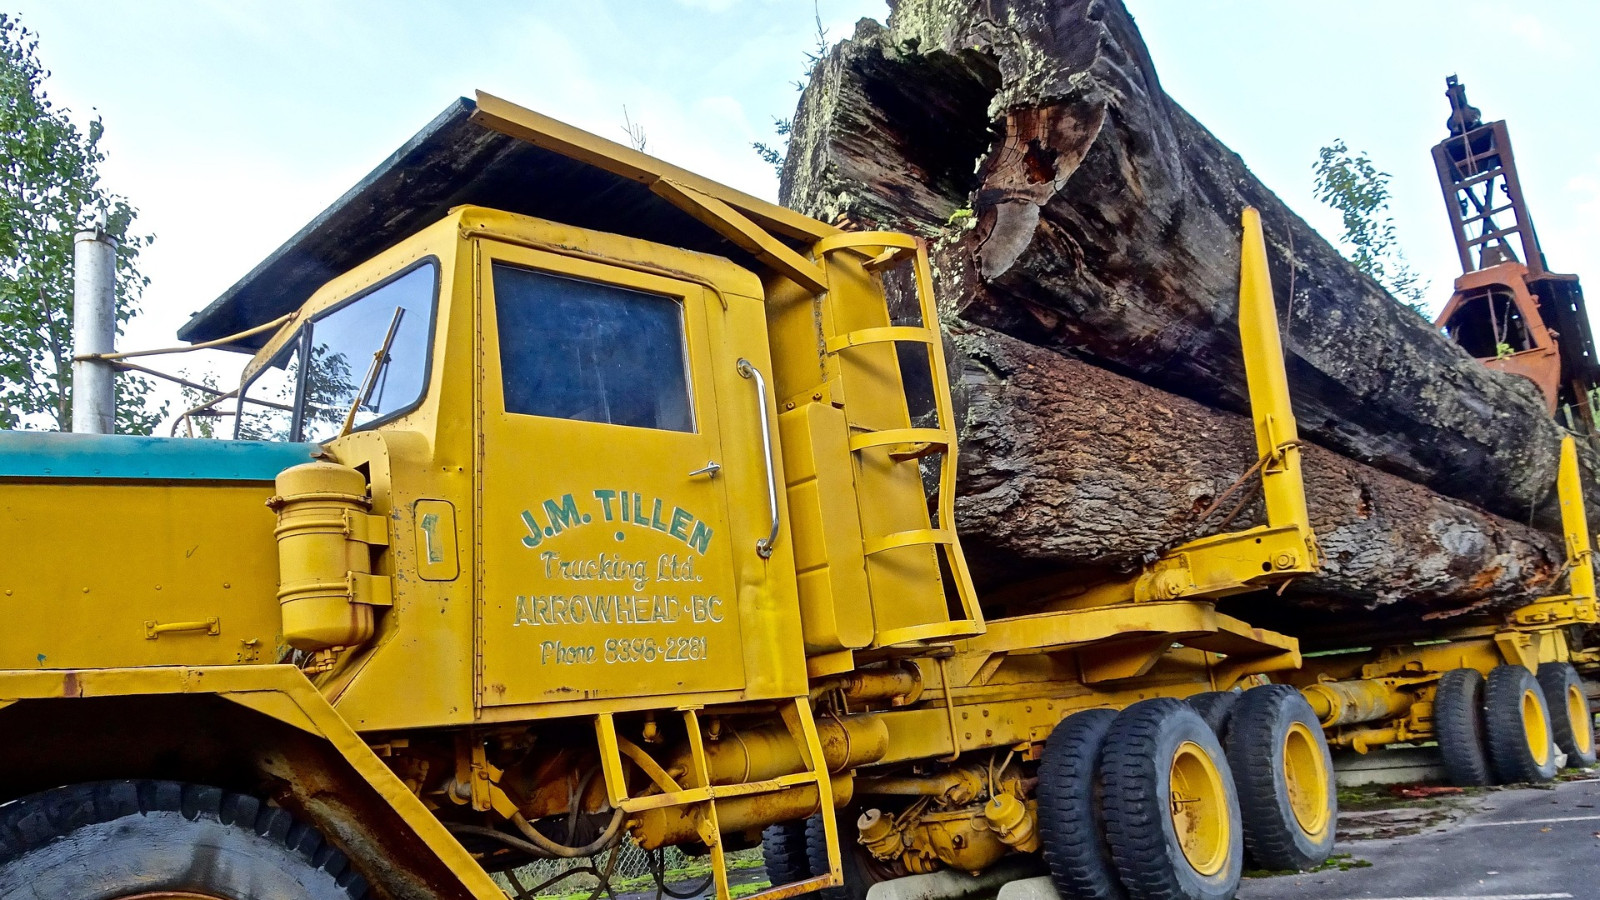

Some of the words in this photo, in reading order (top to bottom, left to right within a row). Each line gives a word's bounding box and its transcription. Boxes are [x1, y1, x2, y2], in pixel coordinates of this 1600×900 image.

[420, 513, 444, 565] 1
[521, 493, 592, 549] J.M.
[593, 489, 713, 555] TILLEN
[540, 551, 649, 591] Trucking
[656, 553, 703, 582] Ltd.
[539, 641, 598, 665] Phone
